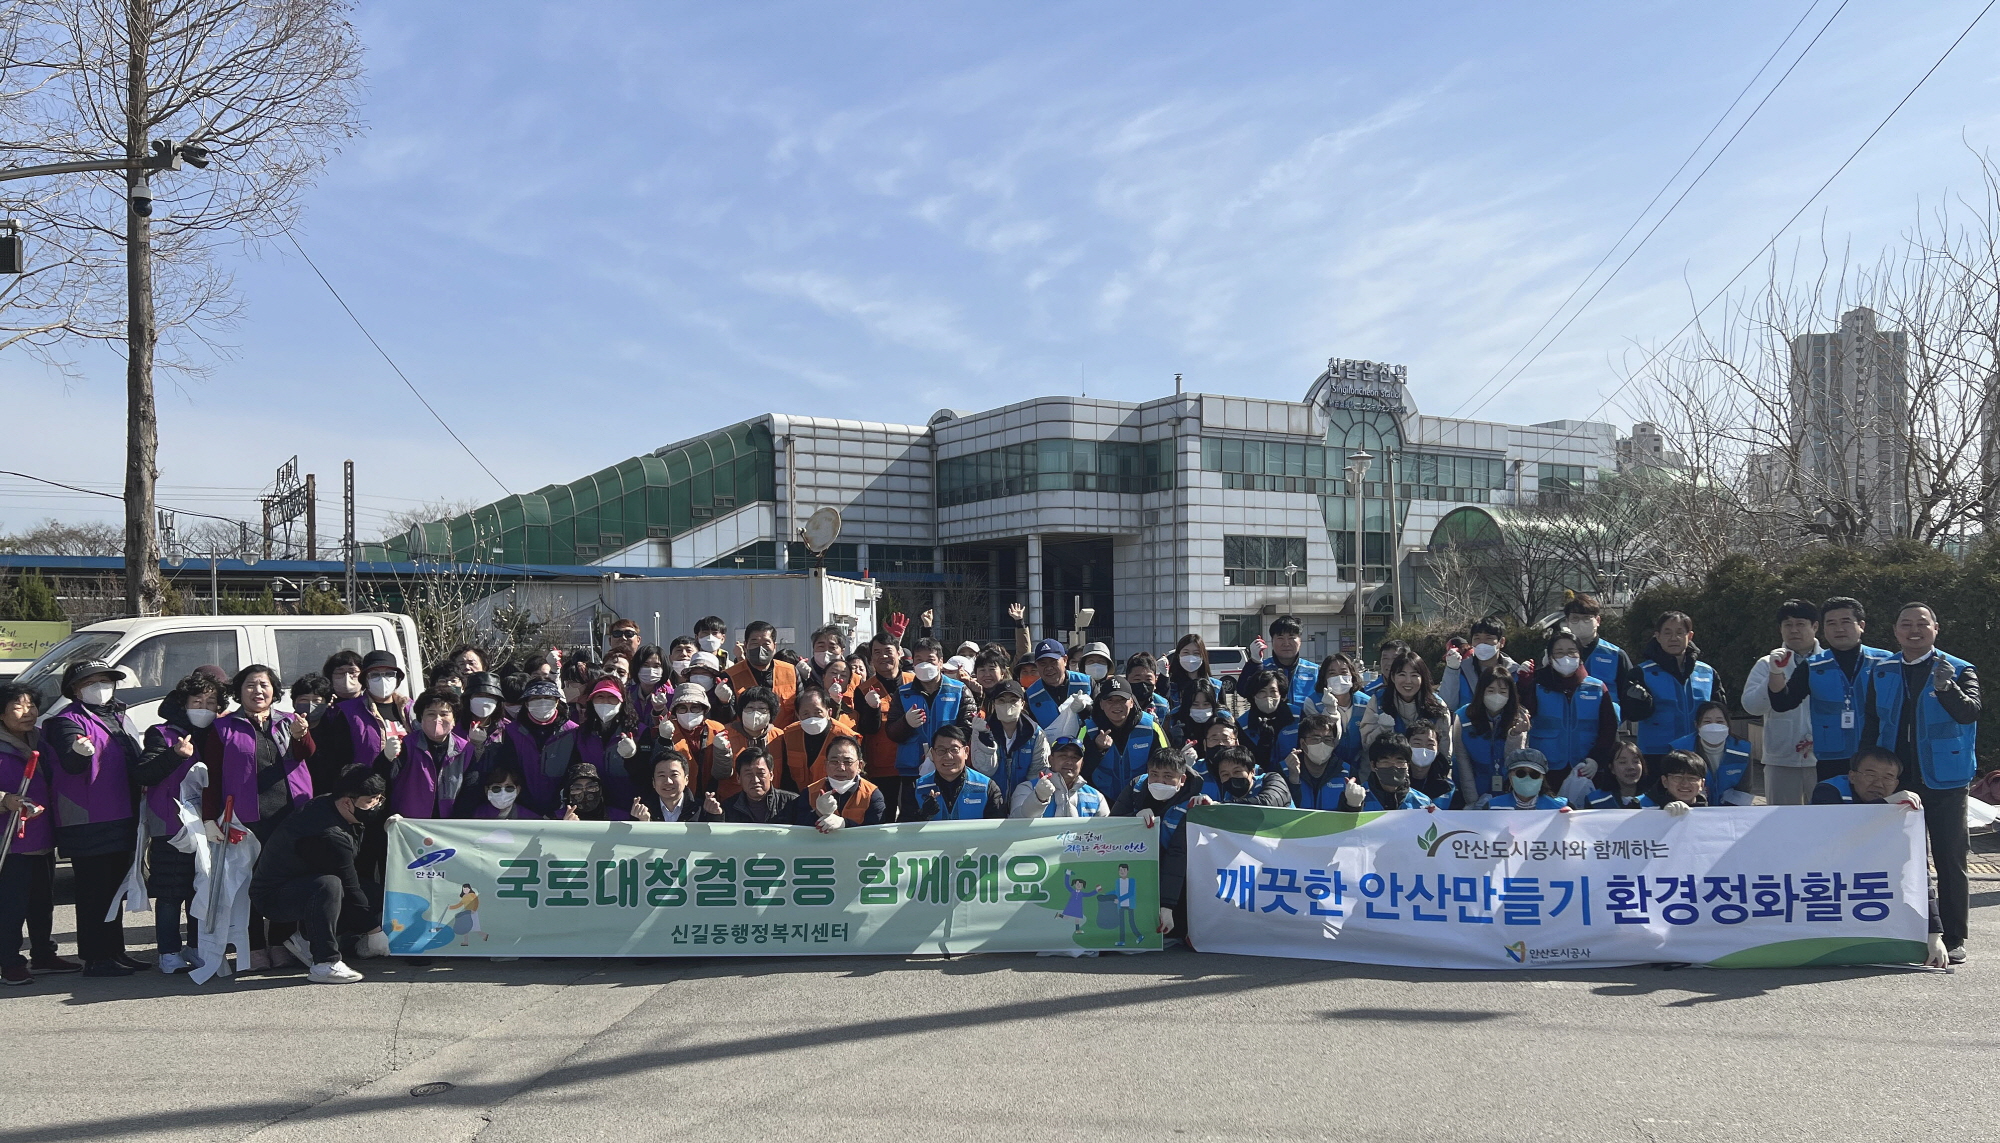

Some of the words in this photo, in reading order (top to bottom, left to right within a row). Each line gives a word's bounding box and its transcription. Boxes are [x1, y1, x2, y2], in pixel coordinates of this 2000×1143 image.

[1328, 357, 1408, 385] 신길온천역
[1331, 383, 1379, 397] Singiloncheon
[1111, 678, 1121, 689] LA
[1123, 842, 1148, 853] 안산
[1451, 839, 1587, 861] 안산도시공사와
[1593, 839, 1670, 860] 함께하는
[415, 870, 446, 880] 안산시
[497, 856, 836, 908] 국토대청결운동
[858, 853, 1050, 905] 함께해요
[1215, 864, 1347, 917] 깨끗한
[1358, 872, 1592, 926] 안산만들기
[1605, 871, 1894, 926] 환경정화활동
[671, 922, 849, 944] 신길동행정복지센터
[1529, 948, 1591, 959] 안산도시공사
